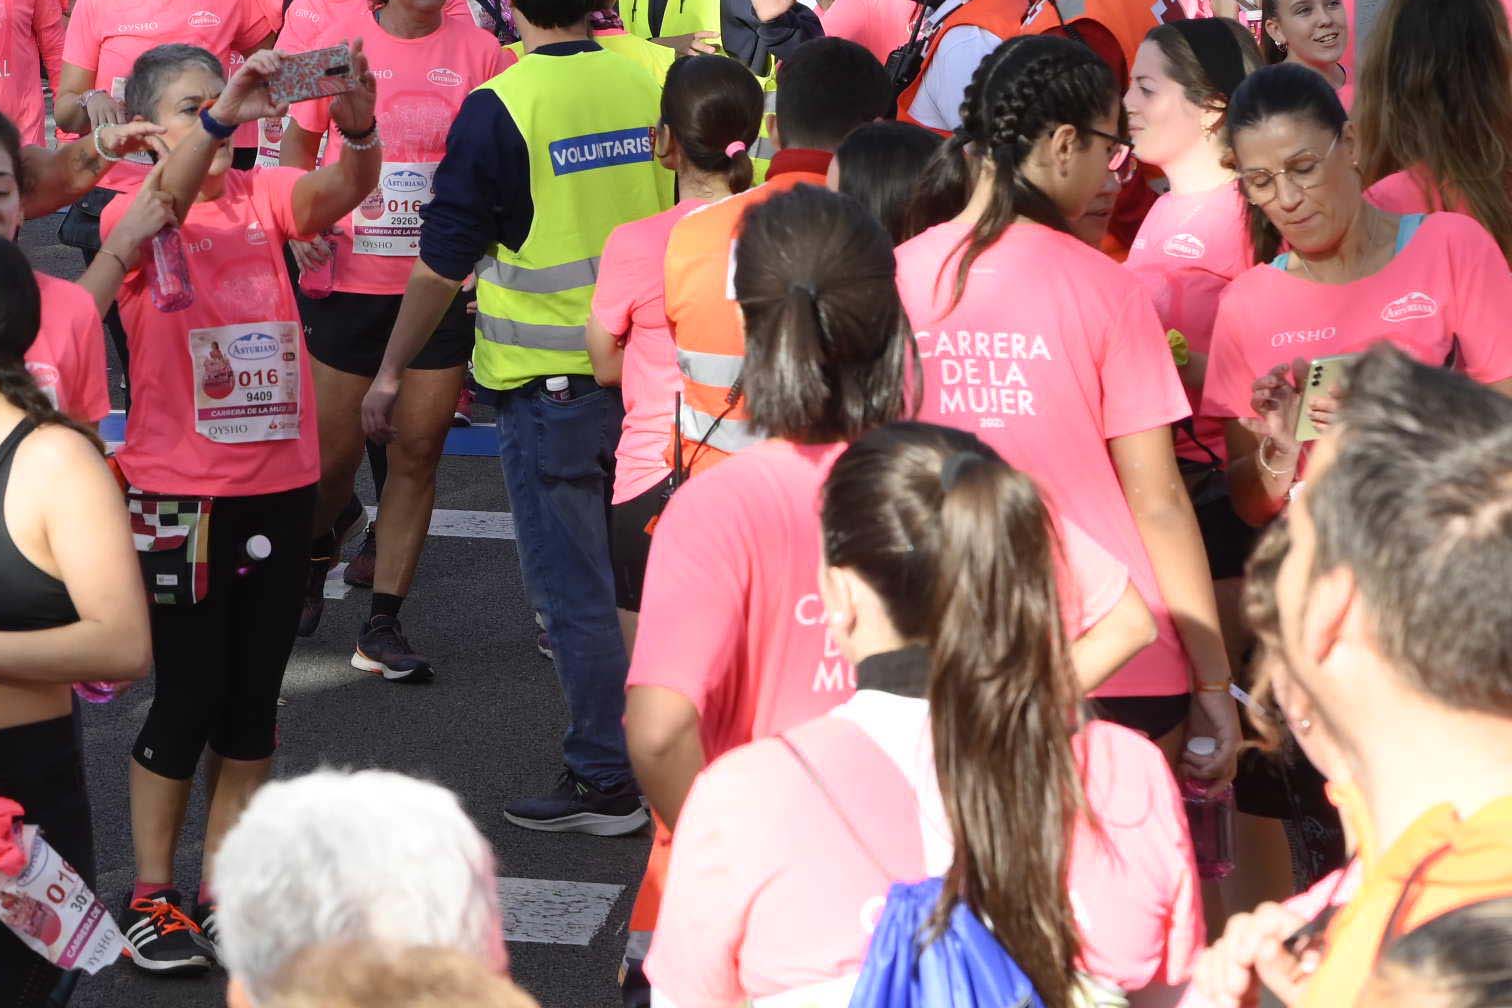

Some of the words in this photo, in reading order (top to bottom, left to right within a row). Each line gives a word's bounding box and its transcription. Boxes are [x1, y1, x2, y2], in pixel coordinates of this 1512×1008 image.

[118, 21, 158, 33] OYSHO
[387, 199, 422, 213] 016
[391, 216, 418, 226] 29263
[362, 240, 393, 249] OYSHO
[1271, 326, 1336, 347] OYSHO
[914, 330, 1053, 361] CARRERA
[238, 369, 279, 387] 016
[941, 358, 981, 385] DE
[989, 360, 1028, 387] LA
[246, 391, 273, 402] 9409
[939, 386, 1036, 417] MUJER
[208, 424, 248, 436] OYSHO
